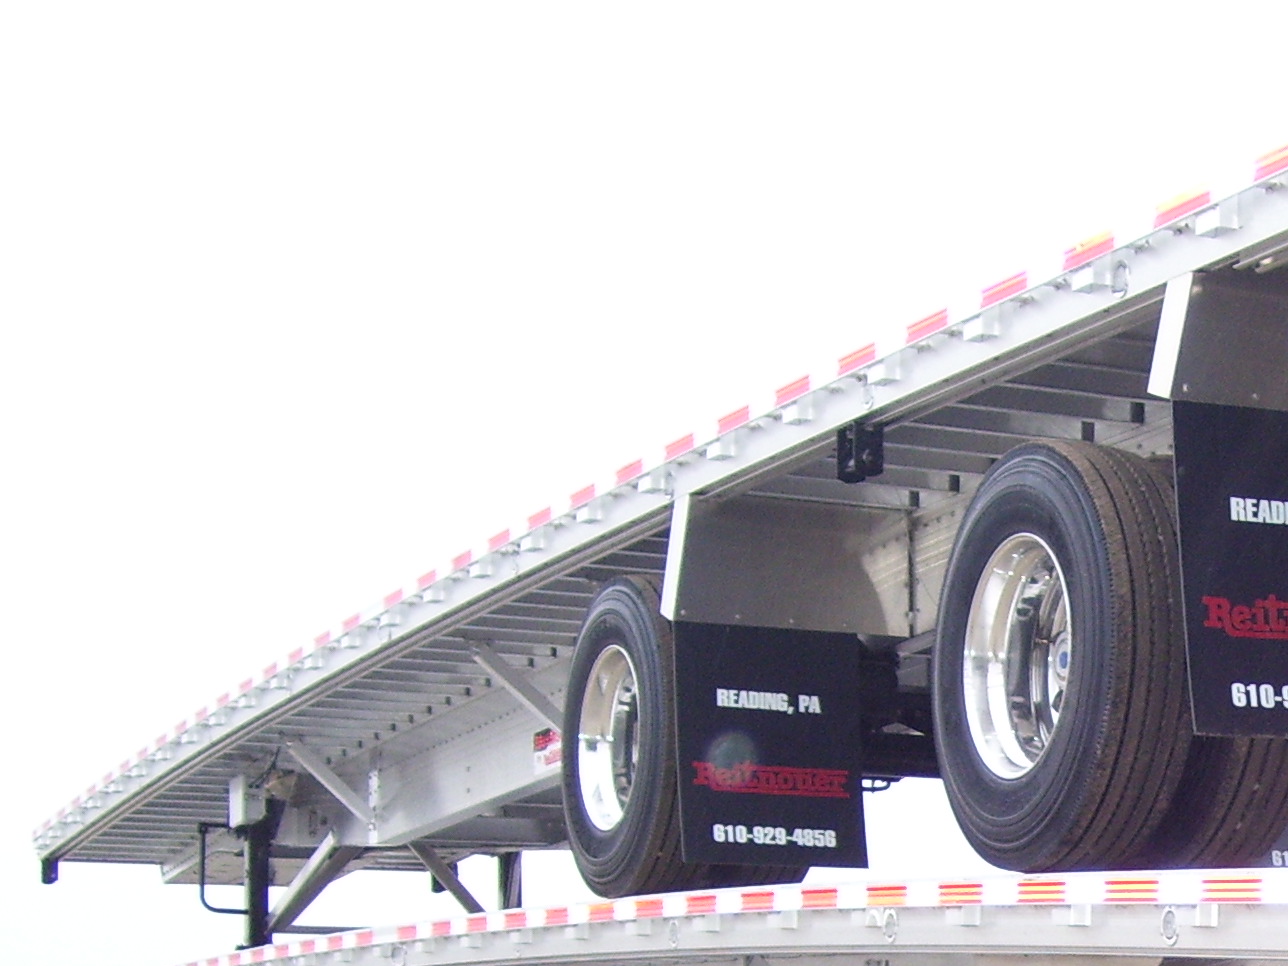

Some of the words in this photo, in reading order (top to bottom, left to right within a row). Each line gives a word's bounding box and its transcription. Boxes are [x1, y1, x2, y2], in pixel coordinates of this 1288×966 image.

[716, 688, 794, 714] READING,
[798, 695, 821, 714] PA
[713, 824, 837, 848] 610-929-4856
